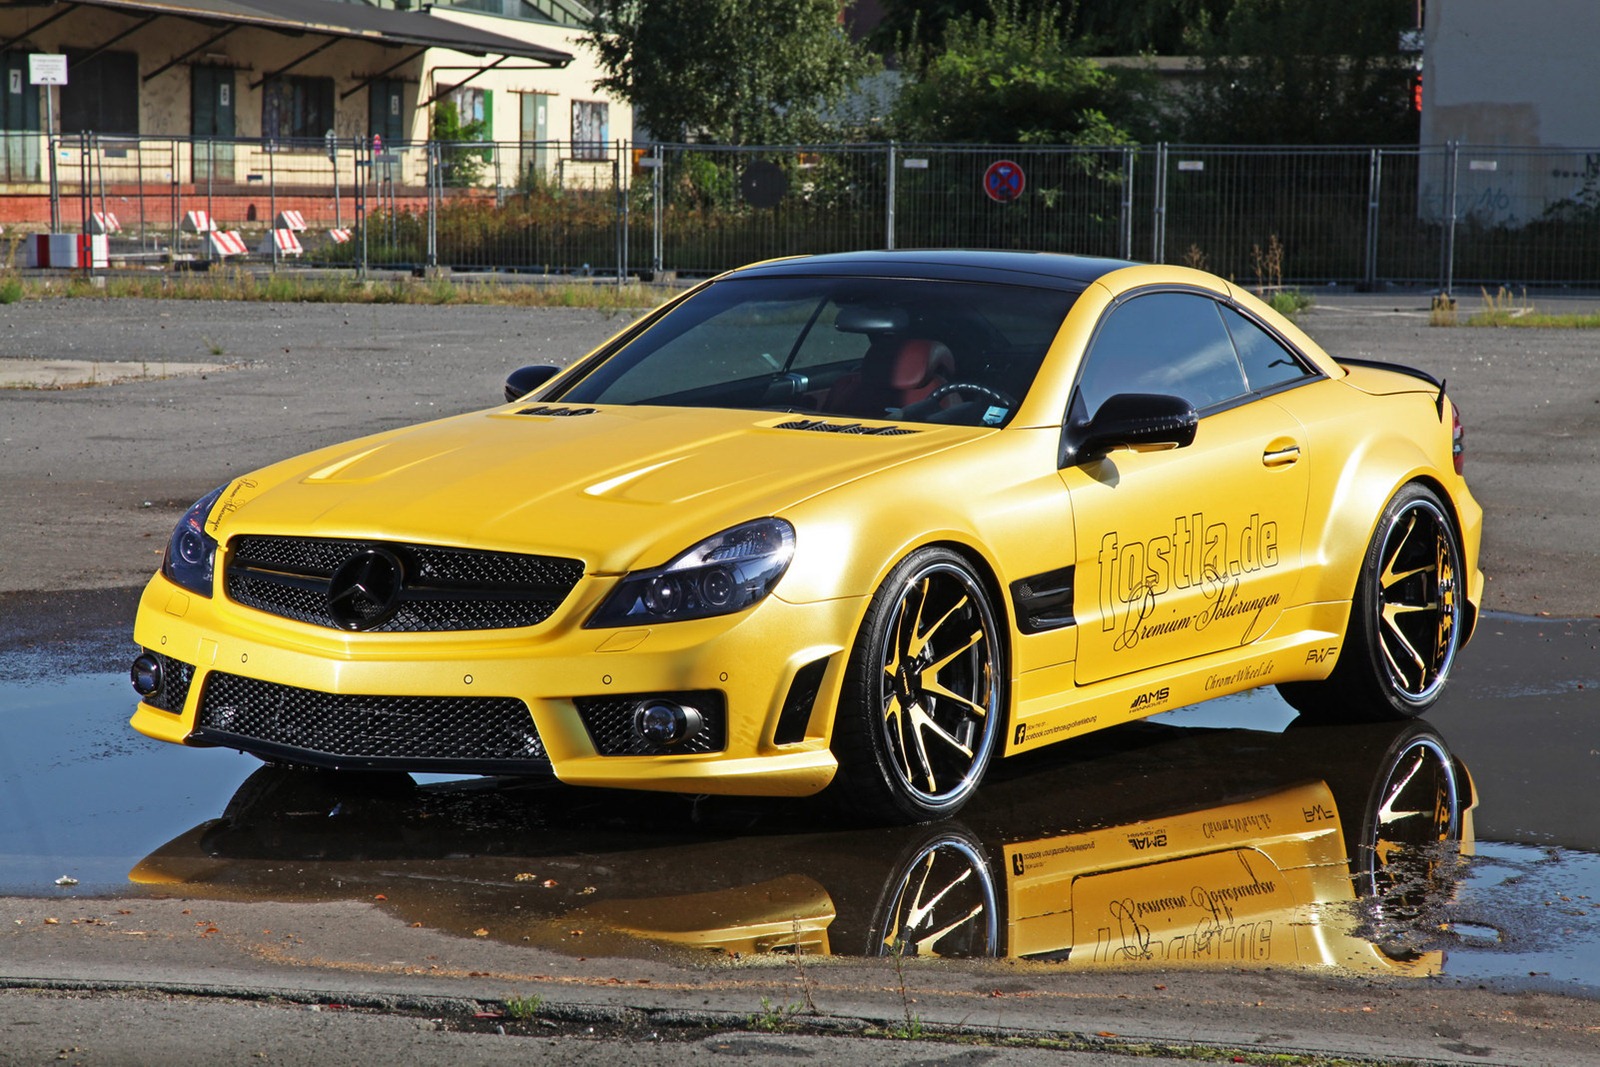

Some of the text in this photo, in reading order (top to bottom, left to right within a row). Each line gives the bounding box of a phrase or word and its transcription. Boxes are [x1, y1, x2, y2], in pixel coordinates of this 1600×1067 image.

[12, 73, 19, 89] 7
[1098, 512, 1279, 632] fostla.de
[1204, 660, 1275, 691] ChromeWheel.de
